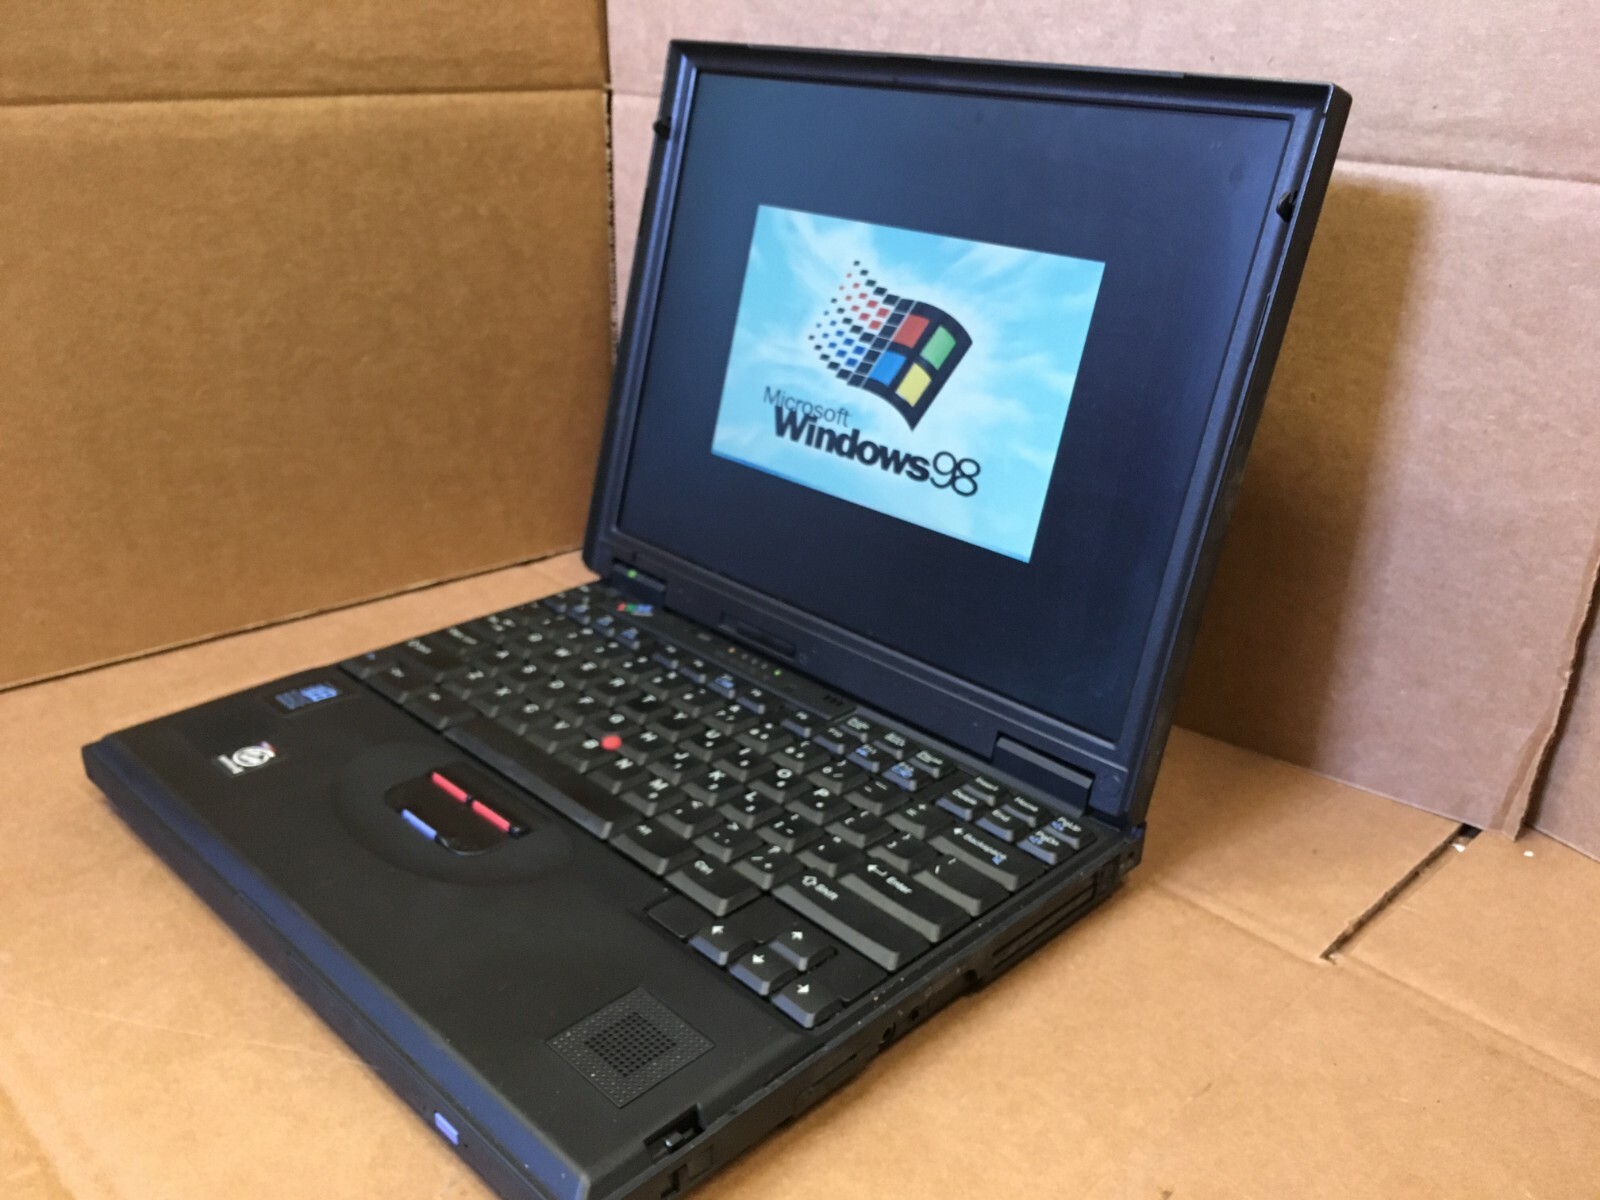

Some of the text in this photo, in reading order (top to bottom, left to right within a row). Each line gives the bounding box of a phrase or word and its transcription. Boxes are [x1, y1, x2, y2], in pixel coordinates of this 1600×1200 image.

[764, 386, 852, 427] Microsoft
[640, 731, 658, 742] H
[614, 758, 634, 769] N
[708, 770, 726, 781] K
[777, 768, 792, 779] O
[649, 778, 669, 791] M
[813, 788, 830, 797] P
[694, 860, 714, 875] Ctrl
[886, 876, 912, 894] Enter
[815, 883, 838, 901] Shift
